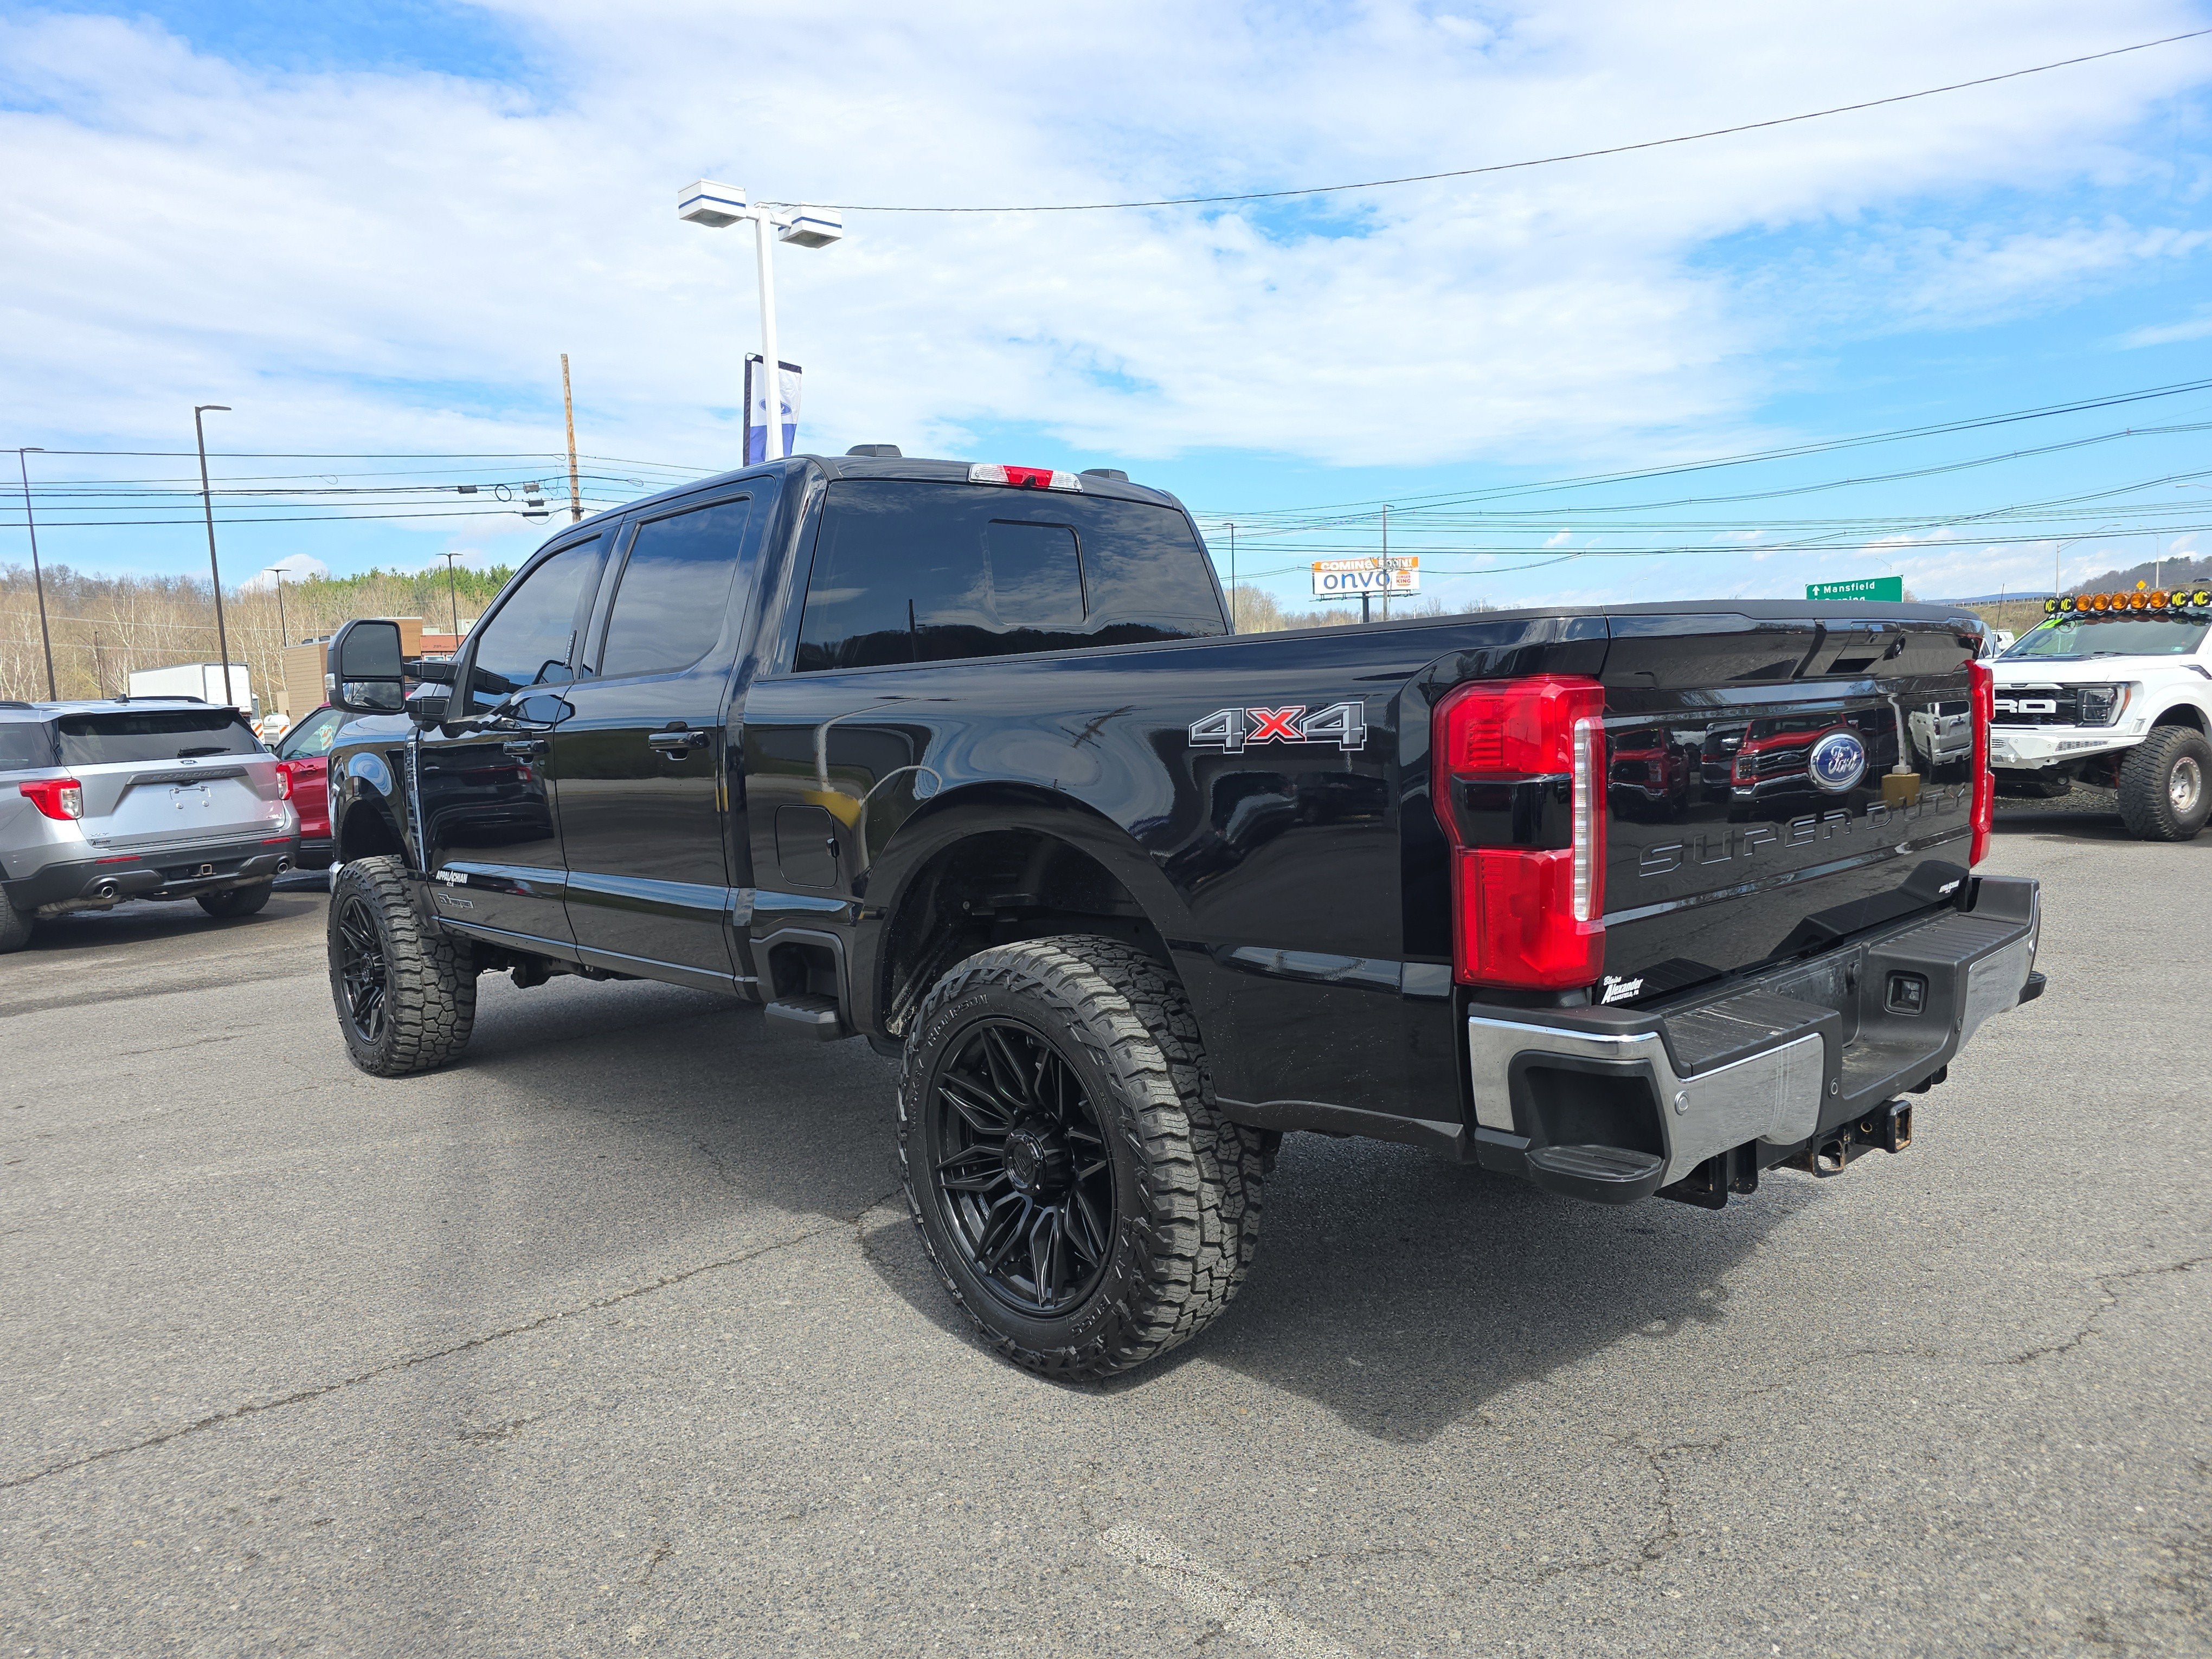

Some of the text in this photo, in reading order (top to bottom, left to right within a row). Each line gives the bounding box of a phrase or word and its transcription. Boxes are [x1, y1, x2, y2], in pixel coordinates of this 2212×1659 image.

[1320, 560, 1374, 571] COMING
[1323, 571, 1390, 589] onvo
[1823, 581, 1875, 594] Mansfield
[2045, 598, 2055, 612] KC
[2061, 597, 2072, 610] KC
[2172, 591, 2186, 605] KC
[2193, 591, 2208, 605] KC
[1189, 701, 1367, 754] 4X4
[1826, 745, 1860, 774] Ford
[150, 770, 230, 781] EXPLORER
[1639, 782, 1966, 878] SUPER DUTY
[435, 870, 468, 884] APPALACHIAN
[1603, 975, 1622, 986] Blaise
[1600, 978, 1644, 1005] Alexander
